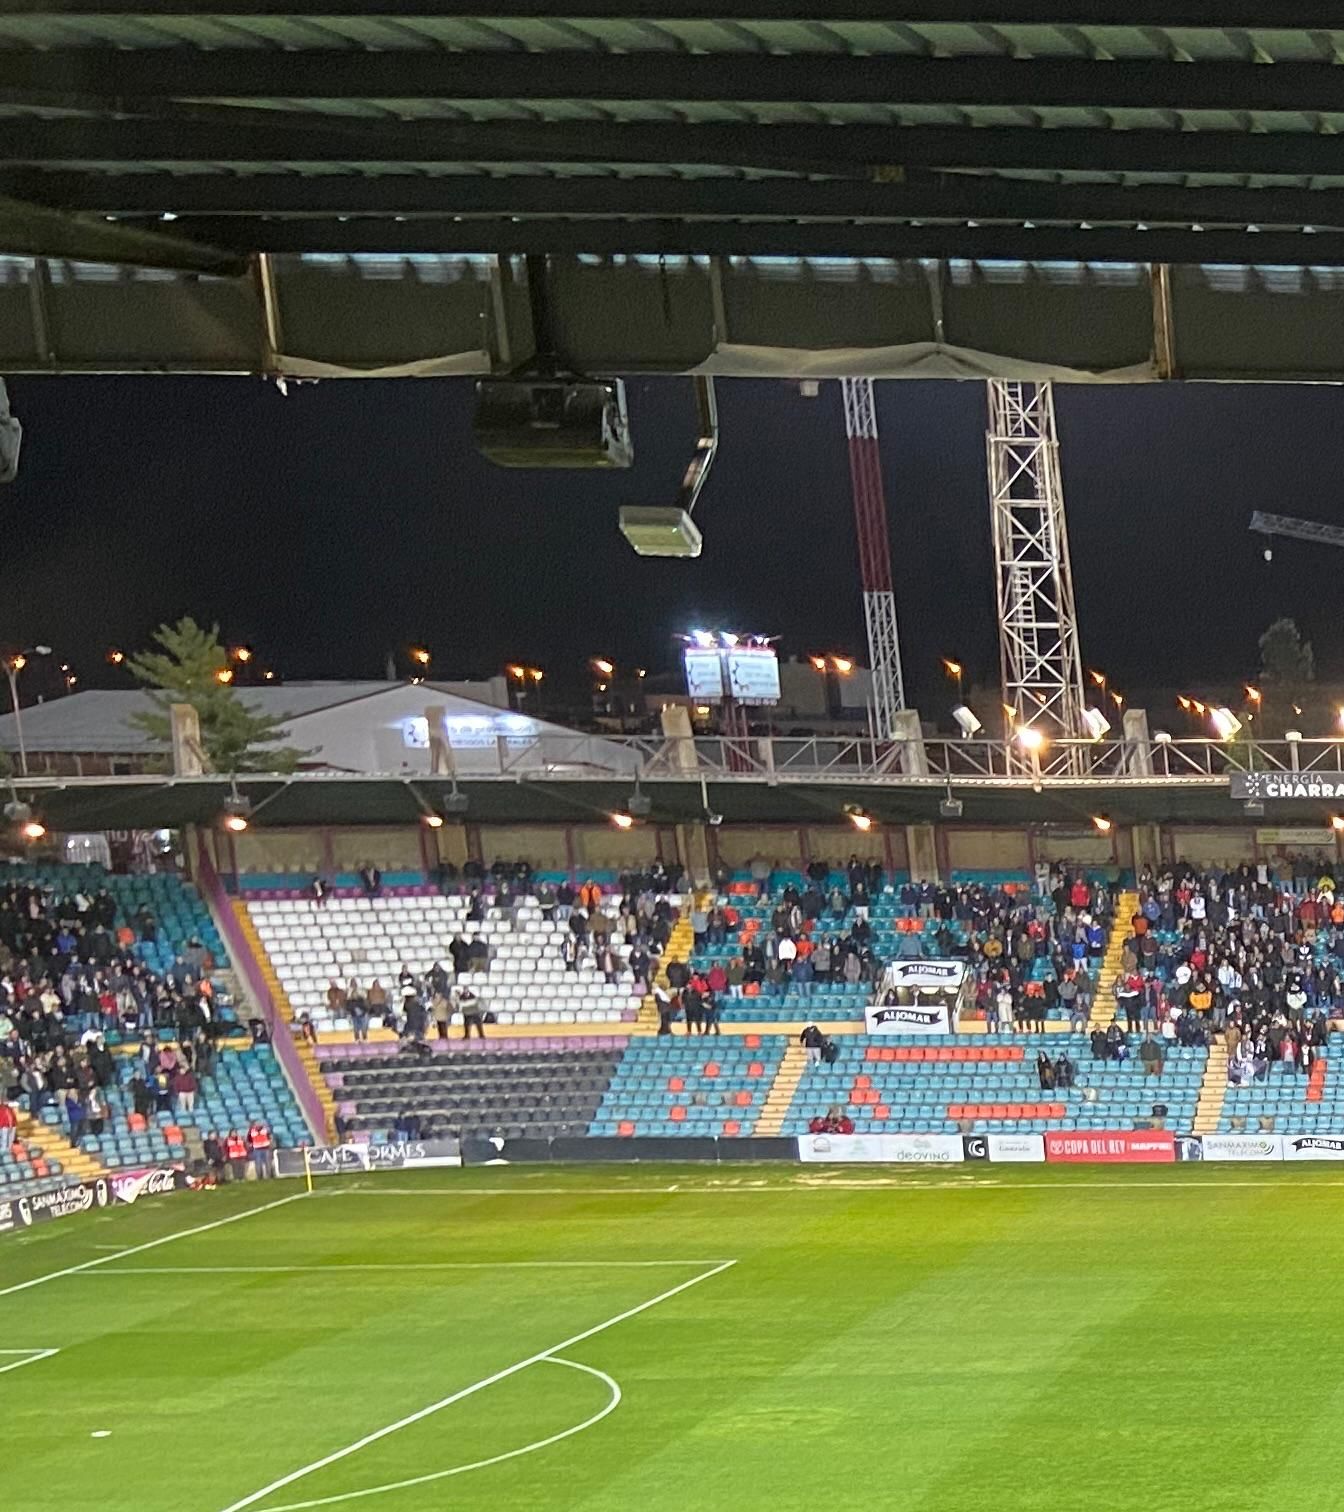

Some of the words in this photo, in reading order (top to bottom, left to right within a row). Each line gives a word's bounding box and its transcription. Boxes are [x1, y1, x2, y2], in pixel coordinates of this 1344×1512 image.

[366, 1141, 427, 1162] ORMES
[1064, 1140, 1089, 1154] COPA
[1091, 1140, 1106, 1154] DEL
[1109, 1139, 1126, 1154] REY
[1131, 1142, 1173, 1152] MAPFRE
[1302, 1139, 1342, 1150] ALJOMAR
